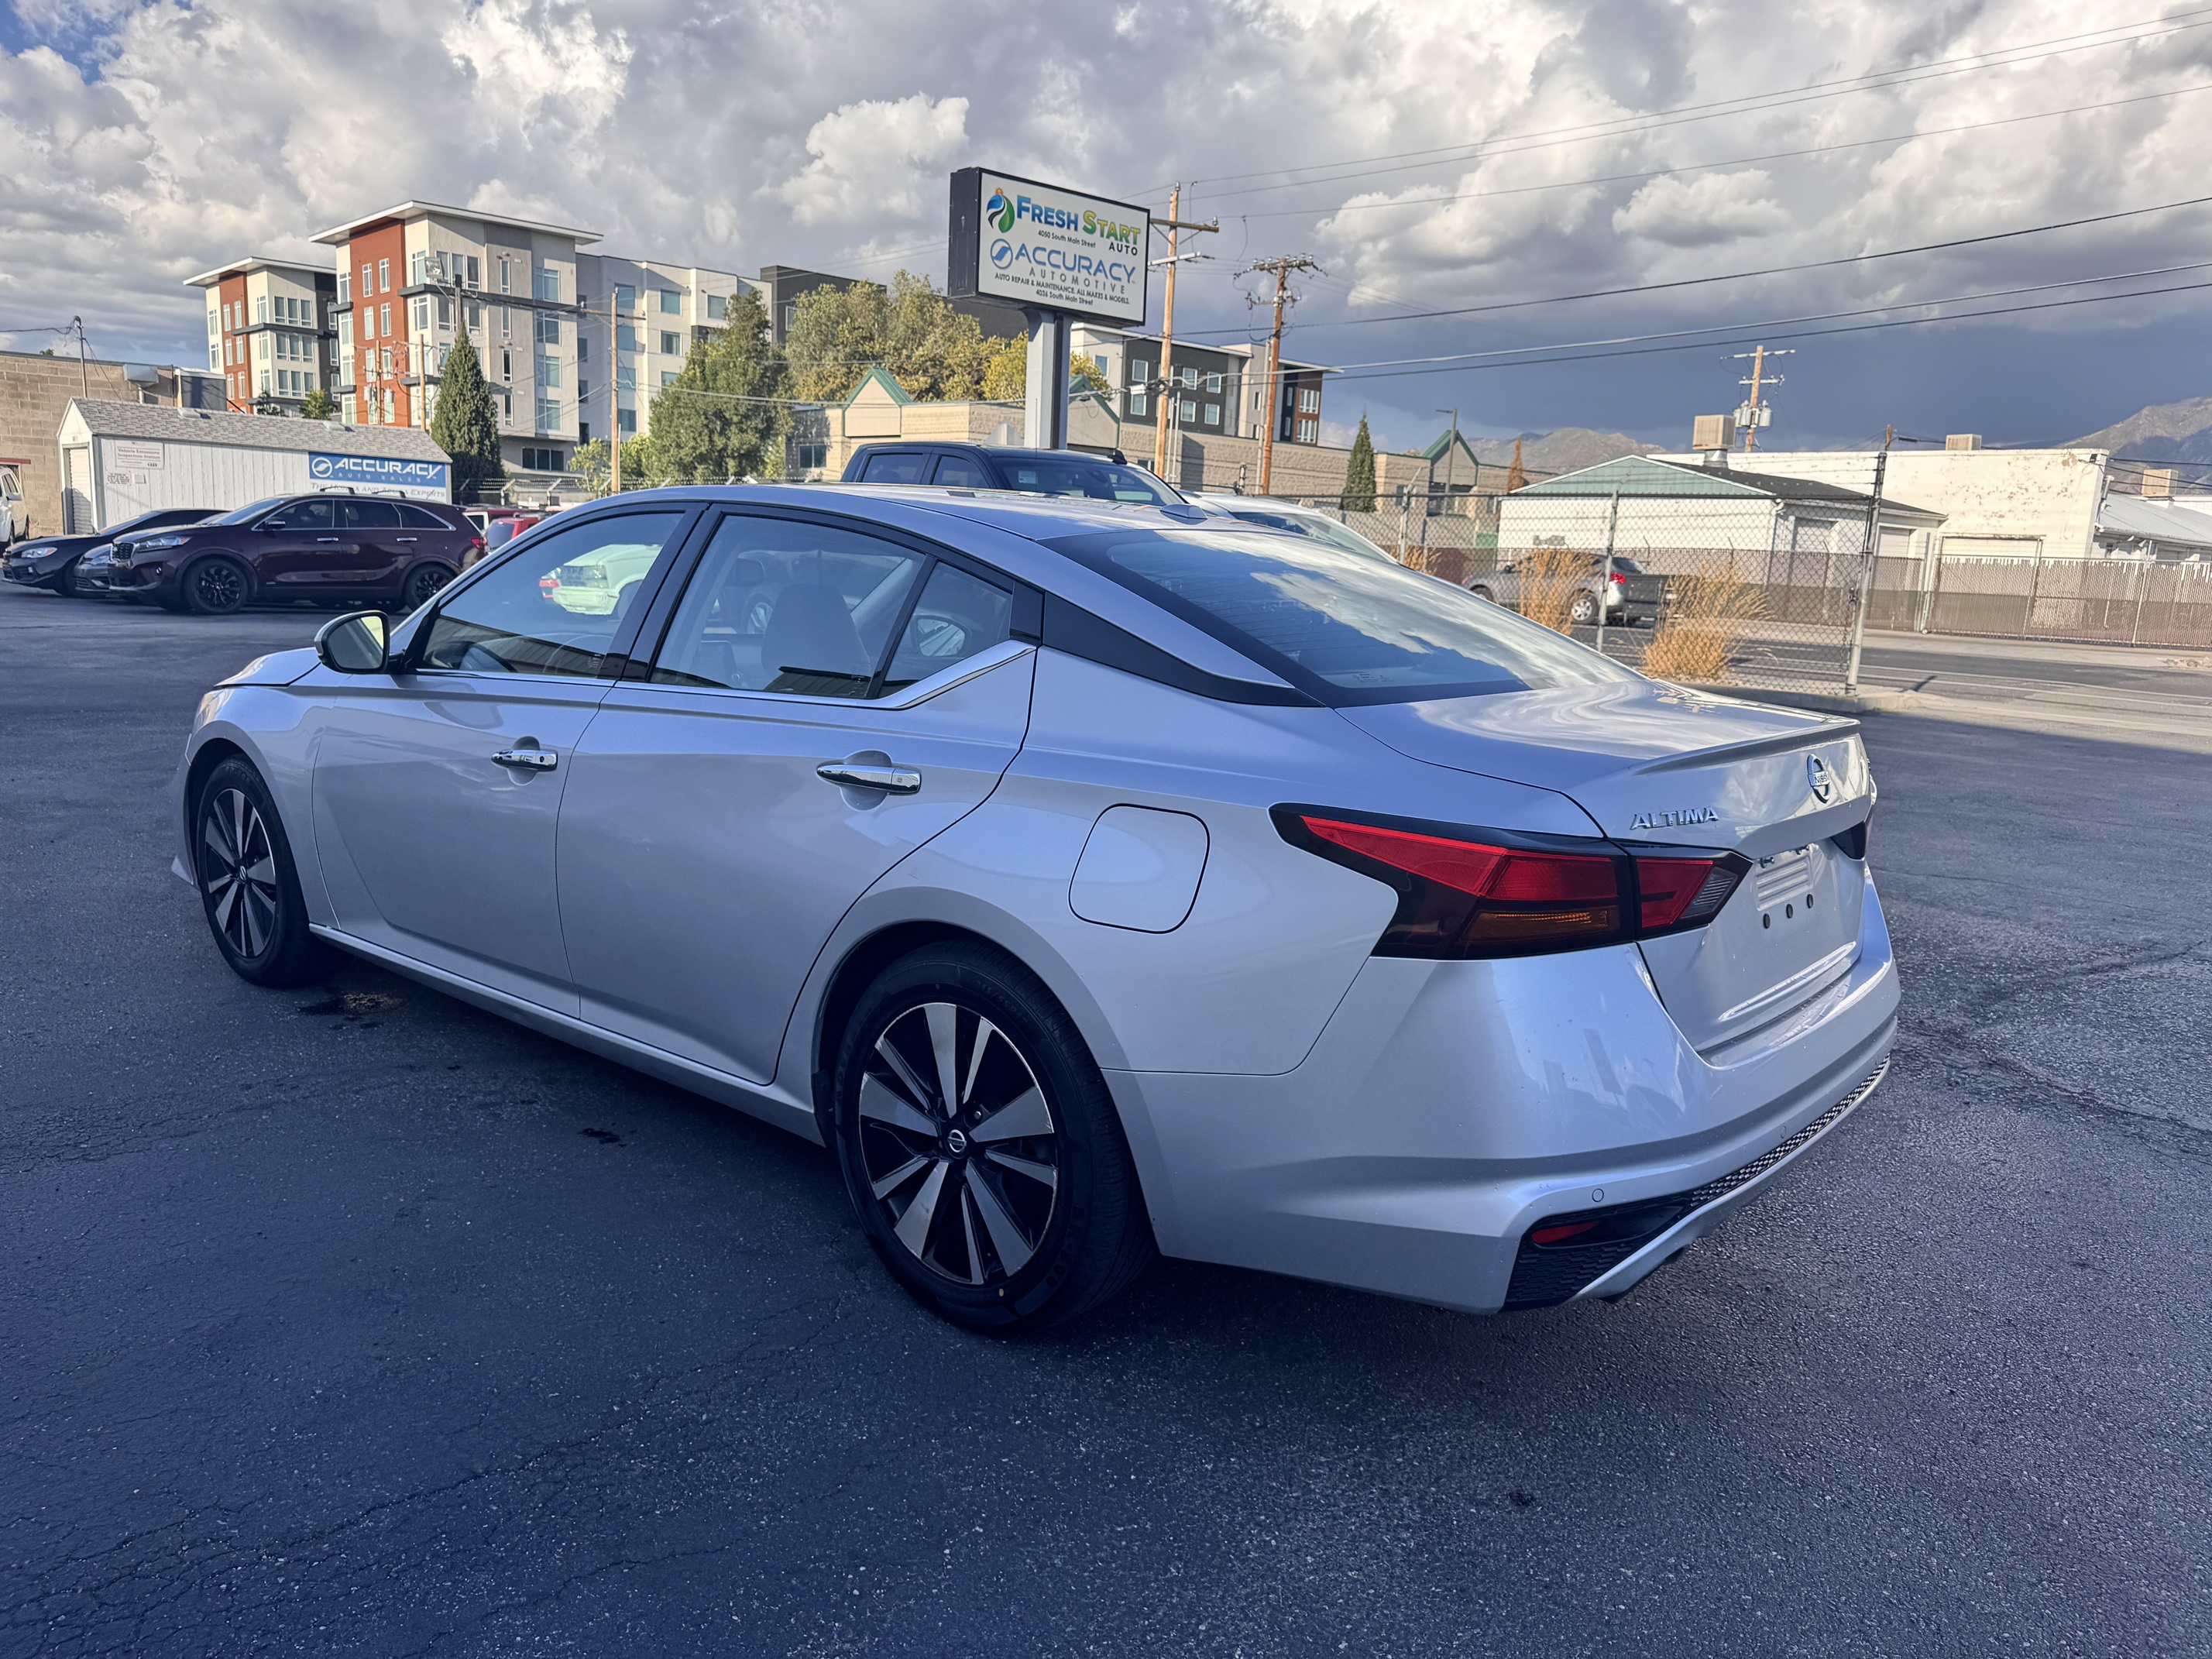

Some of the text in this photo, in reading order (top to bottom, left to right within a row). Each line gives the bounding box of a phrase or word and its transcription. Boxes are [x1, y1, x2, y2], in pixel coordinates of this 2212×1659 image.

[1017, 195, 1141, 246] FRESH START
[1038, 229, 1096, 249] 4050 South Main Street
[1108, 241, 1138, 256] AUTO
[1015, 243, 1136, 283] ACCURACY
[994, 272, 1010, 282] AUTO
[1012, 275, 1029, 286] REPAIR
[1086, 290, 1104, 300] MAKES
[1029, 266, 1125, 294] AUTOMOTIVE
[1049, 290, 1064, 300] South
[1065, 294, 1078, 304] Main
[1079, 297, 1094, 306] Street
[335, 458, 442, 479] ACCURACY
[381, 475, 421, 483] SALES
[1630, 806, 1719, 830] ALTIMA
